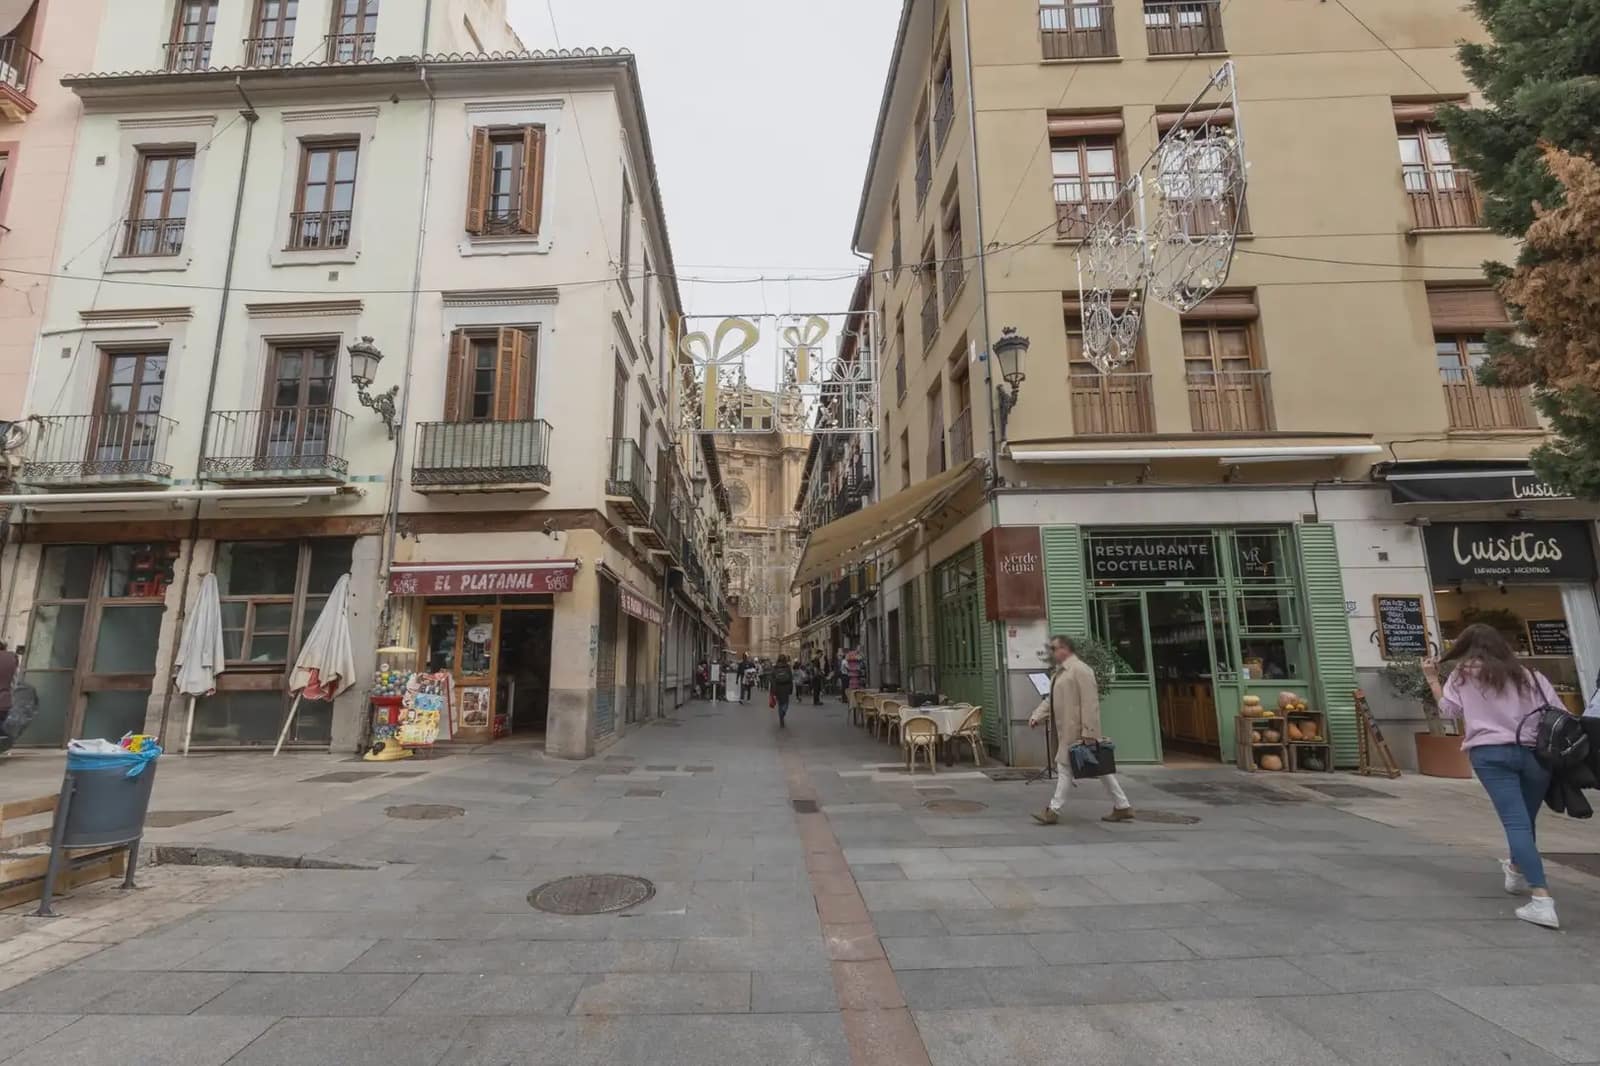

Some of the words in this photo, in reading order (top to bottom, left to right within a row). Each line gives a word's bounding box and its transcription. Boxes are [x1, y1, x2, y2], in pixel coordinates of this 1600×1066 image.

[1095, 544, 1209, 557] RESTAURANTE
[1452, 525, 1563, 565] Luisitas
[1096, 557, 1195, 572] COCTELERÍA
[434, 575, 451, 592] EL
[460, 573, 534, 592] PLATANAL
